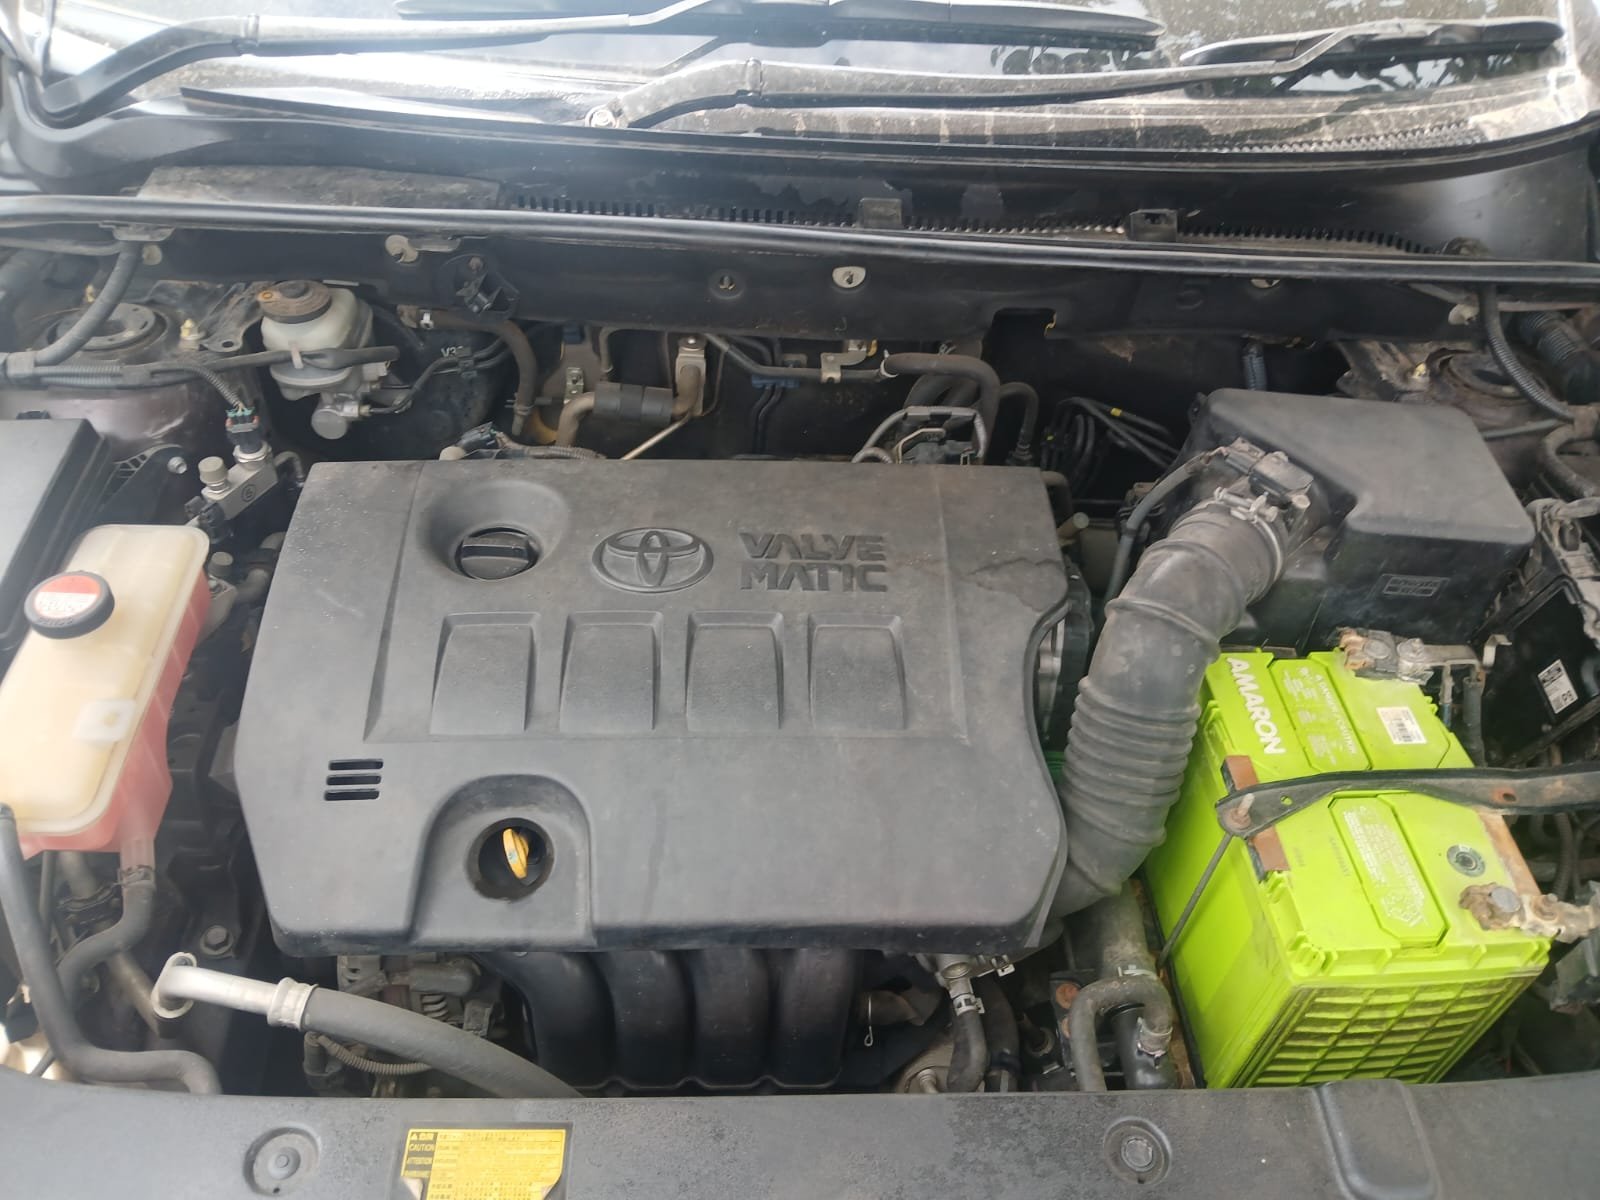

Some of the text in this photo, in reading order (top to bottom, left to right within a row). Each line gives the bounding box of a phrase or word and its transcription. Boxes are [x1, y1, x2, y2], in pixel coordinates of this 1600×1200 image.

[738, 532, 887, 561] VALVE
[739, 561, 888, 592] MATIC
[1227, 657, 1286, 754] AMARON
[408, 1143, 435, 1152] CAUTION
